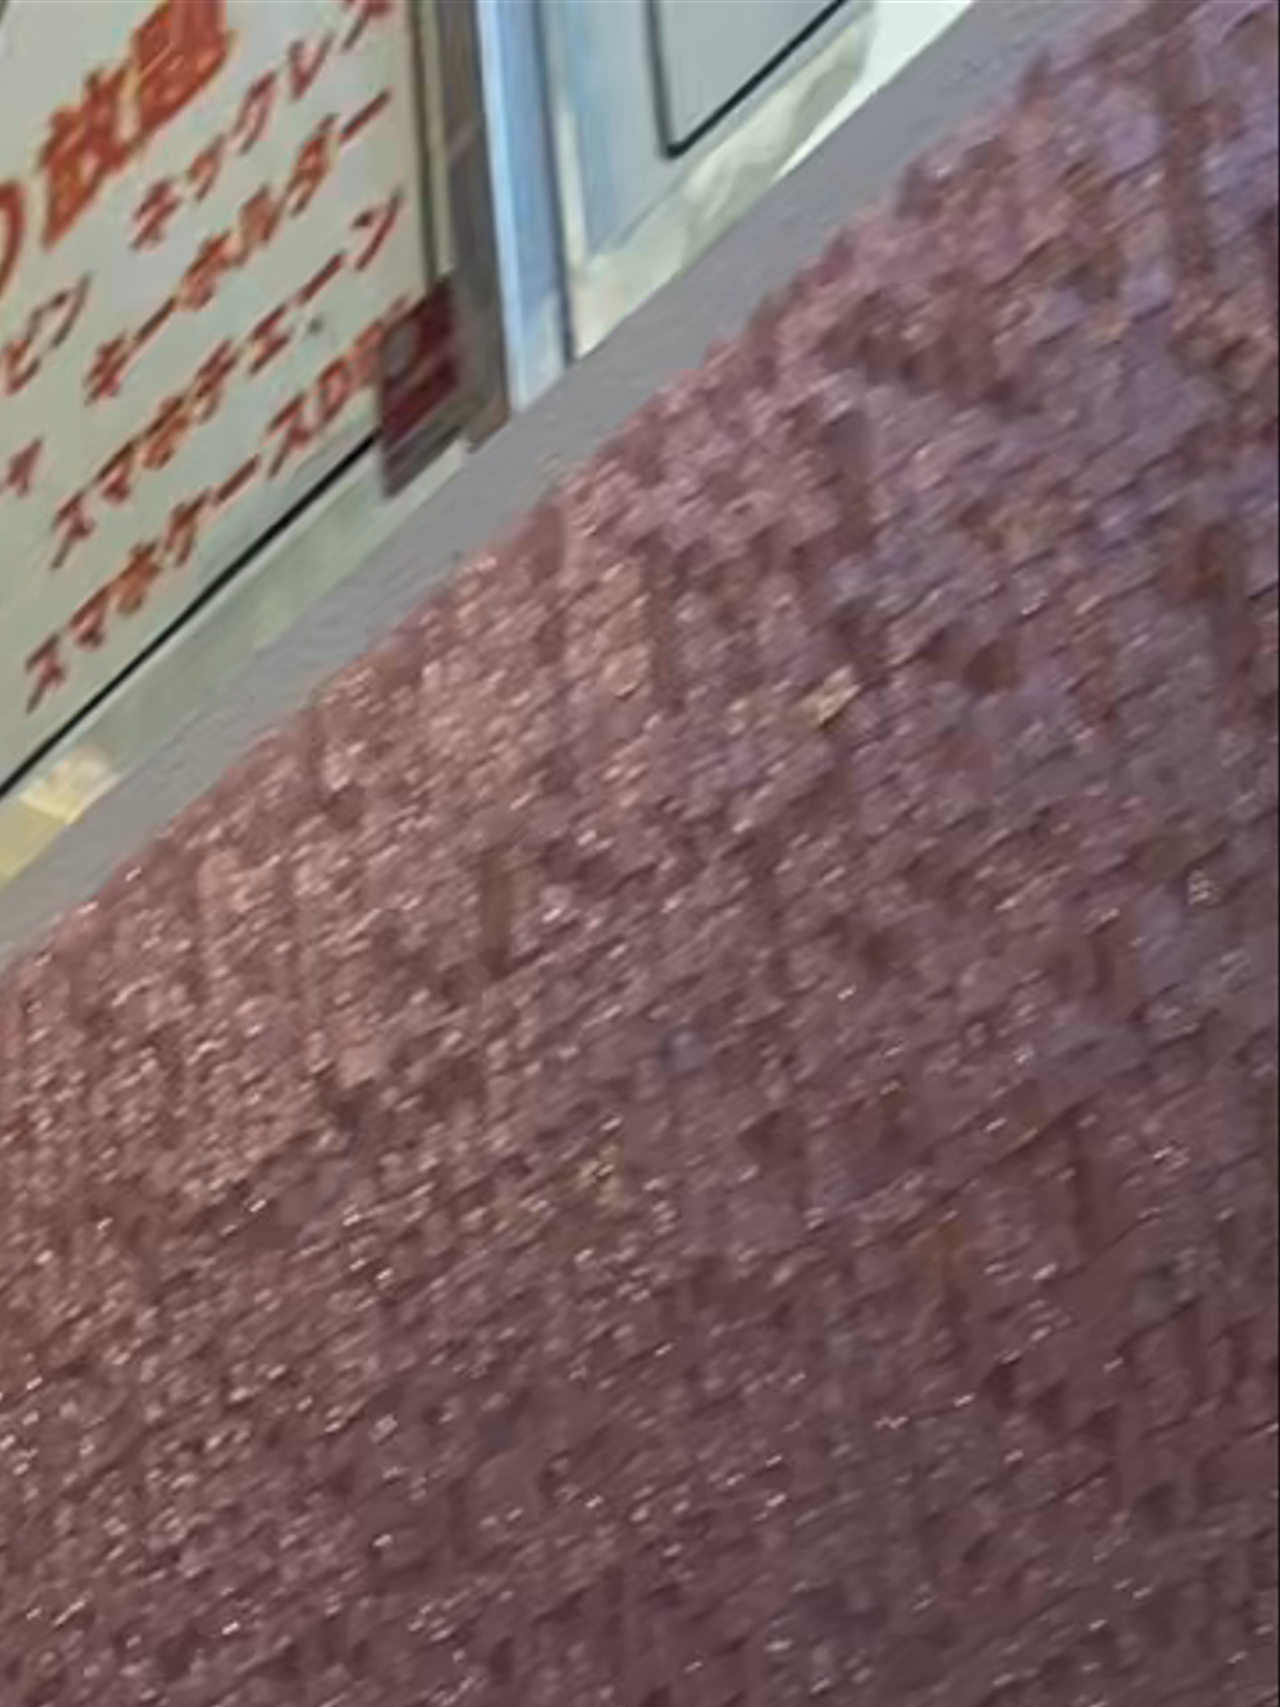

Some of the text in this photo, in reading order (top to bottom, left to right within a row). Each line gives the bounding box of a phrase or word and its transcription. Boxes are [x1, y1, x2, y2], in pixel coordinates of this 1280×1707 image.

[51, 186, 402, 569] スマホチェーン
[85, 90, 392, 405] キーホルダー
